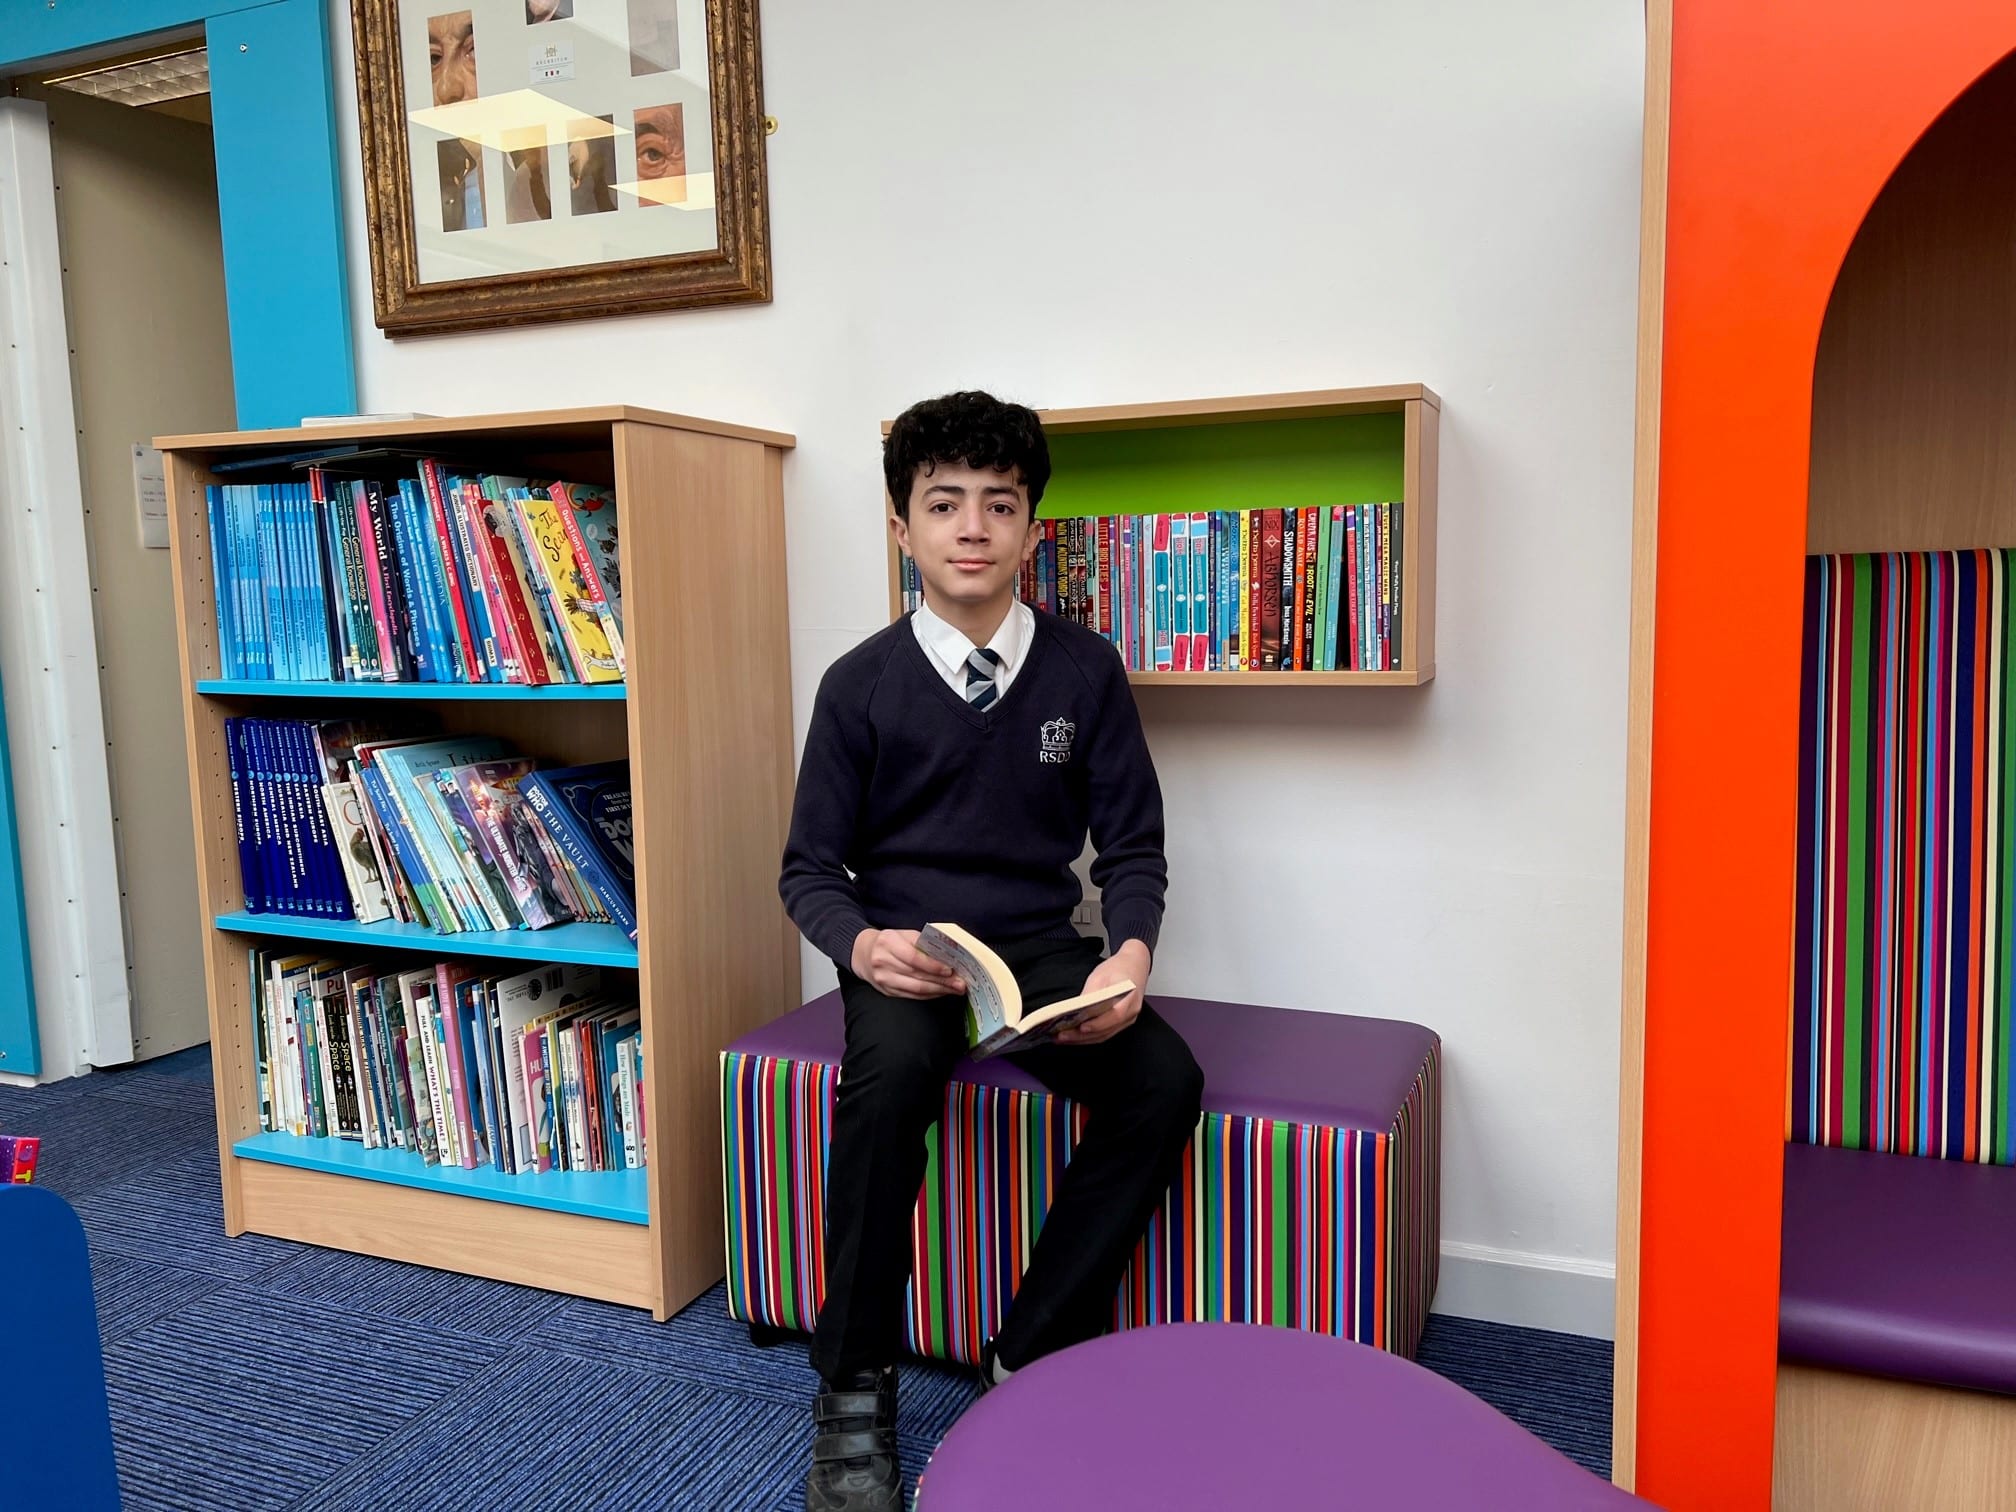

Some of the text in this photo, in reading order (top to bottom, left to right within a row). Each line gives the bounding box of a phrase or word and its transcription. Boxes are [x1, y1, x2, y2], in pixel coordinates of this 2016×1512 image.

[367, 491, 380, 513] My
[390, 501, 400, 519] The
[423, 464, 434, 487] PICTURE
[429, 488, 441, 522] DICTIONARY
[371, 516, 389, 560] World
[392, 520, 406, 554] Origins
[451, 493, 478, 586] JUNIOR ILLUSTRATED DICTIONARY
[1099, 524, 1108, 546] LITTLE
[1265, 520, 1280, 530] NIX
[1297, 519, 1305, 544] ROALD
[340, 536, 359, 600] General Knowledge
[350, 536, 370, 600] General Knowledge
[400, 556, 408, 566] of
[560, 508, 583, 551] Questions
[580, 560, 602, 598] Answers
[1100, 548, 1108, 562] BIRD
[1100, 565, 1109, 582] FLIES
[1283, 531, 1294, 585] SHADOWSMITH
[382, 572, 391, 588] First
[401, 568, 414, 598] Words
[1305, 570, 1314, 616] ROOT EVIL
[384, 590, 400, 635] Encyclopedia
[408, 609, 423, 647] Phrases
[232, 780, 244, 840] WESTERN EUROPE
[248, 780, 262, 845] NORTHERN EUROPE
[258, 781, 271, 838] NORTH AMERICA
[267, 781, 281, 845] CENTRAL AMERICA
[287, 796, 296, 822] INDIAN
[302, 783, 318, 842] EASTERN EUROPE
[526, 789, 545, 812] WHO
[276, 783, 287, 821] AUSTRALIA
[288, 857, 298, 888] ZEALAND
[291, 823, 306, 876] SUBCONTINENT
[320, 828, 328, 845] ASIA
[488, 825, 507, 852] ULTIMATE
[501, 851, 519, 877] MONSTER
[542, 809, 590, 869] THE VAULT
[599, 885, 629, 925] MARCUS HEARN
[330, 1041, 343, 1070] Space
[341, 1042, 354, 1071] Space
[425, 1045, 433, 1063] LEARN
[433, 1099, 441, 1114] THE
[619, 1069, 628, 1088] Things
